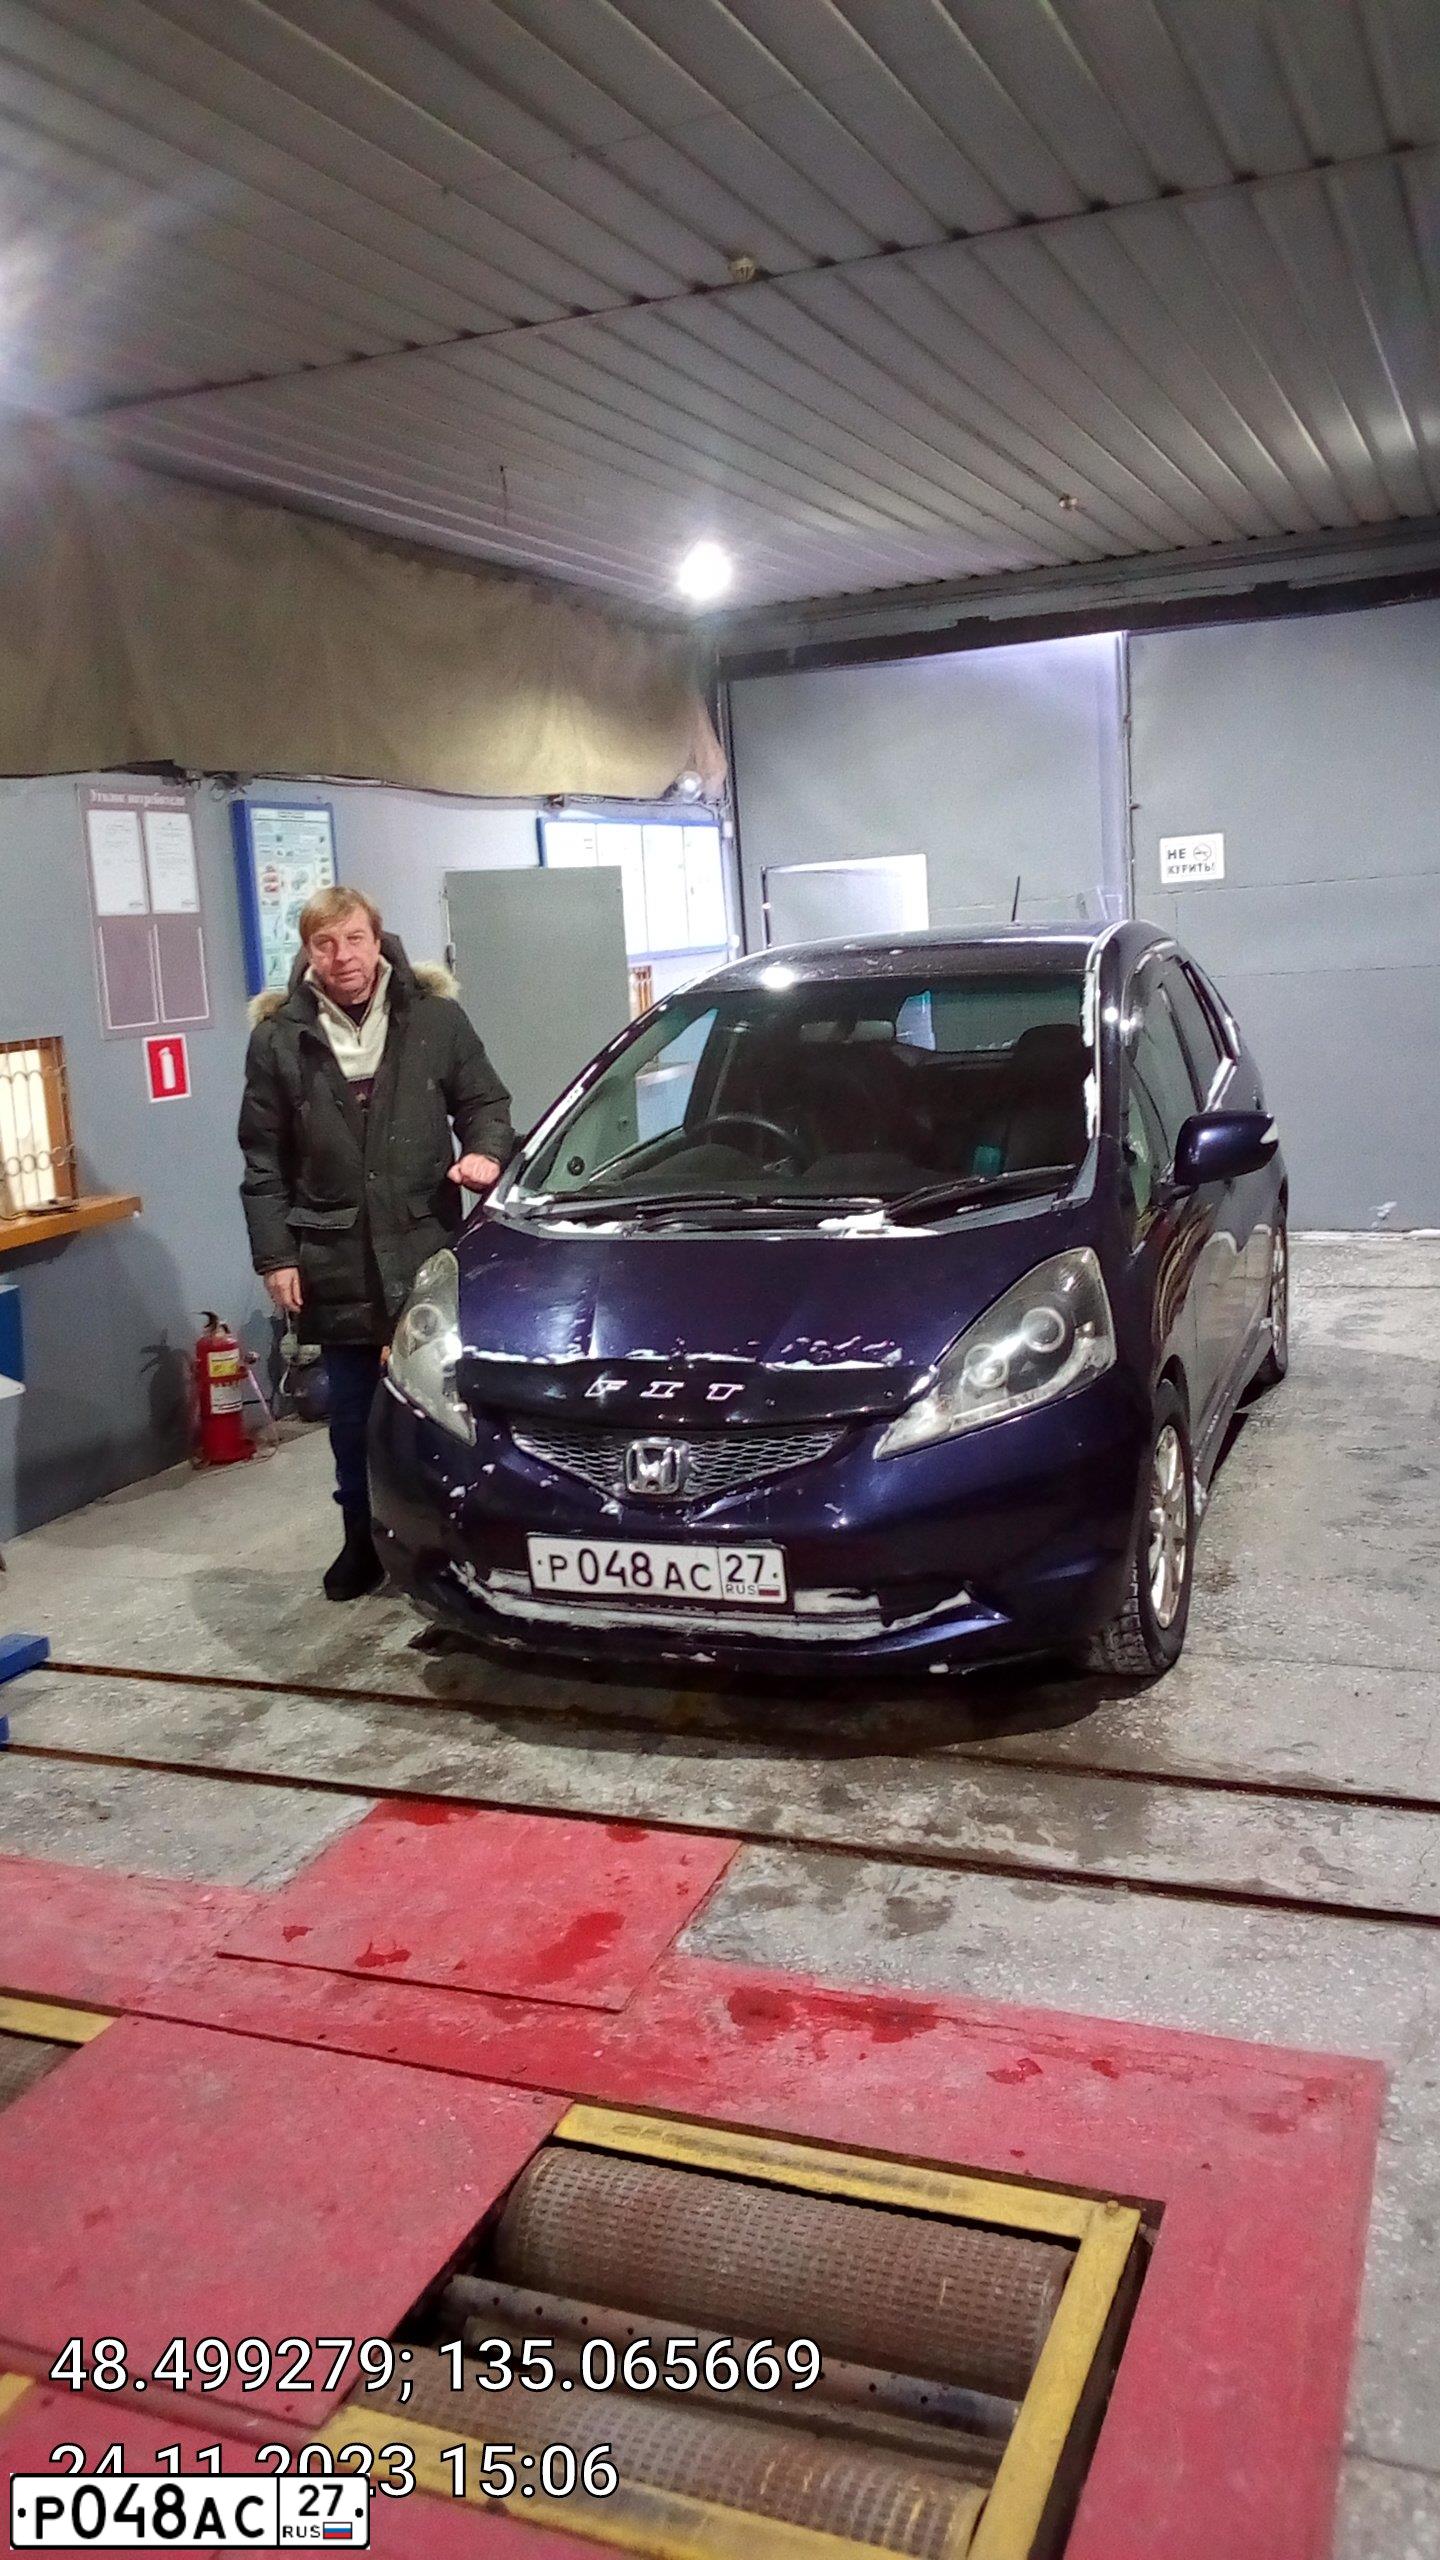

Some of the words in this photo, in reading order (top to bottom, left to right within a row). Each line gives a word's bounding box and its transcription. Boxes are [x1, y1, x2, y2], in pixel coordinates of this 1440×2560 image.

[1167, 848, 1187, 860] НЕ
[725, 1553, 765, 1583] 27
[725, 1584, 756, 1595] RUS
